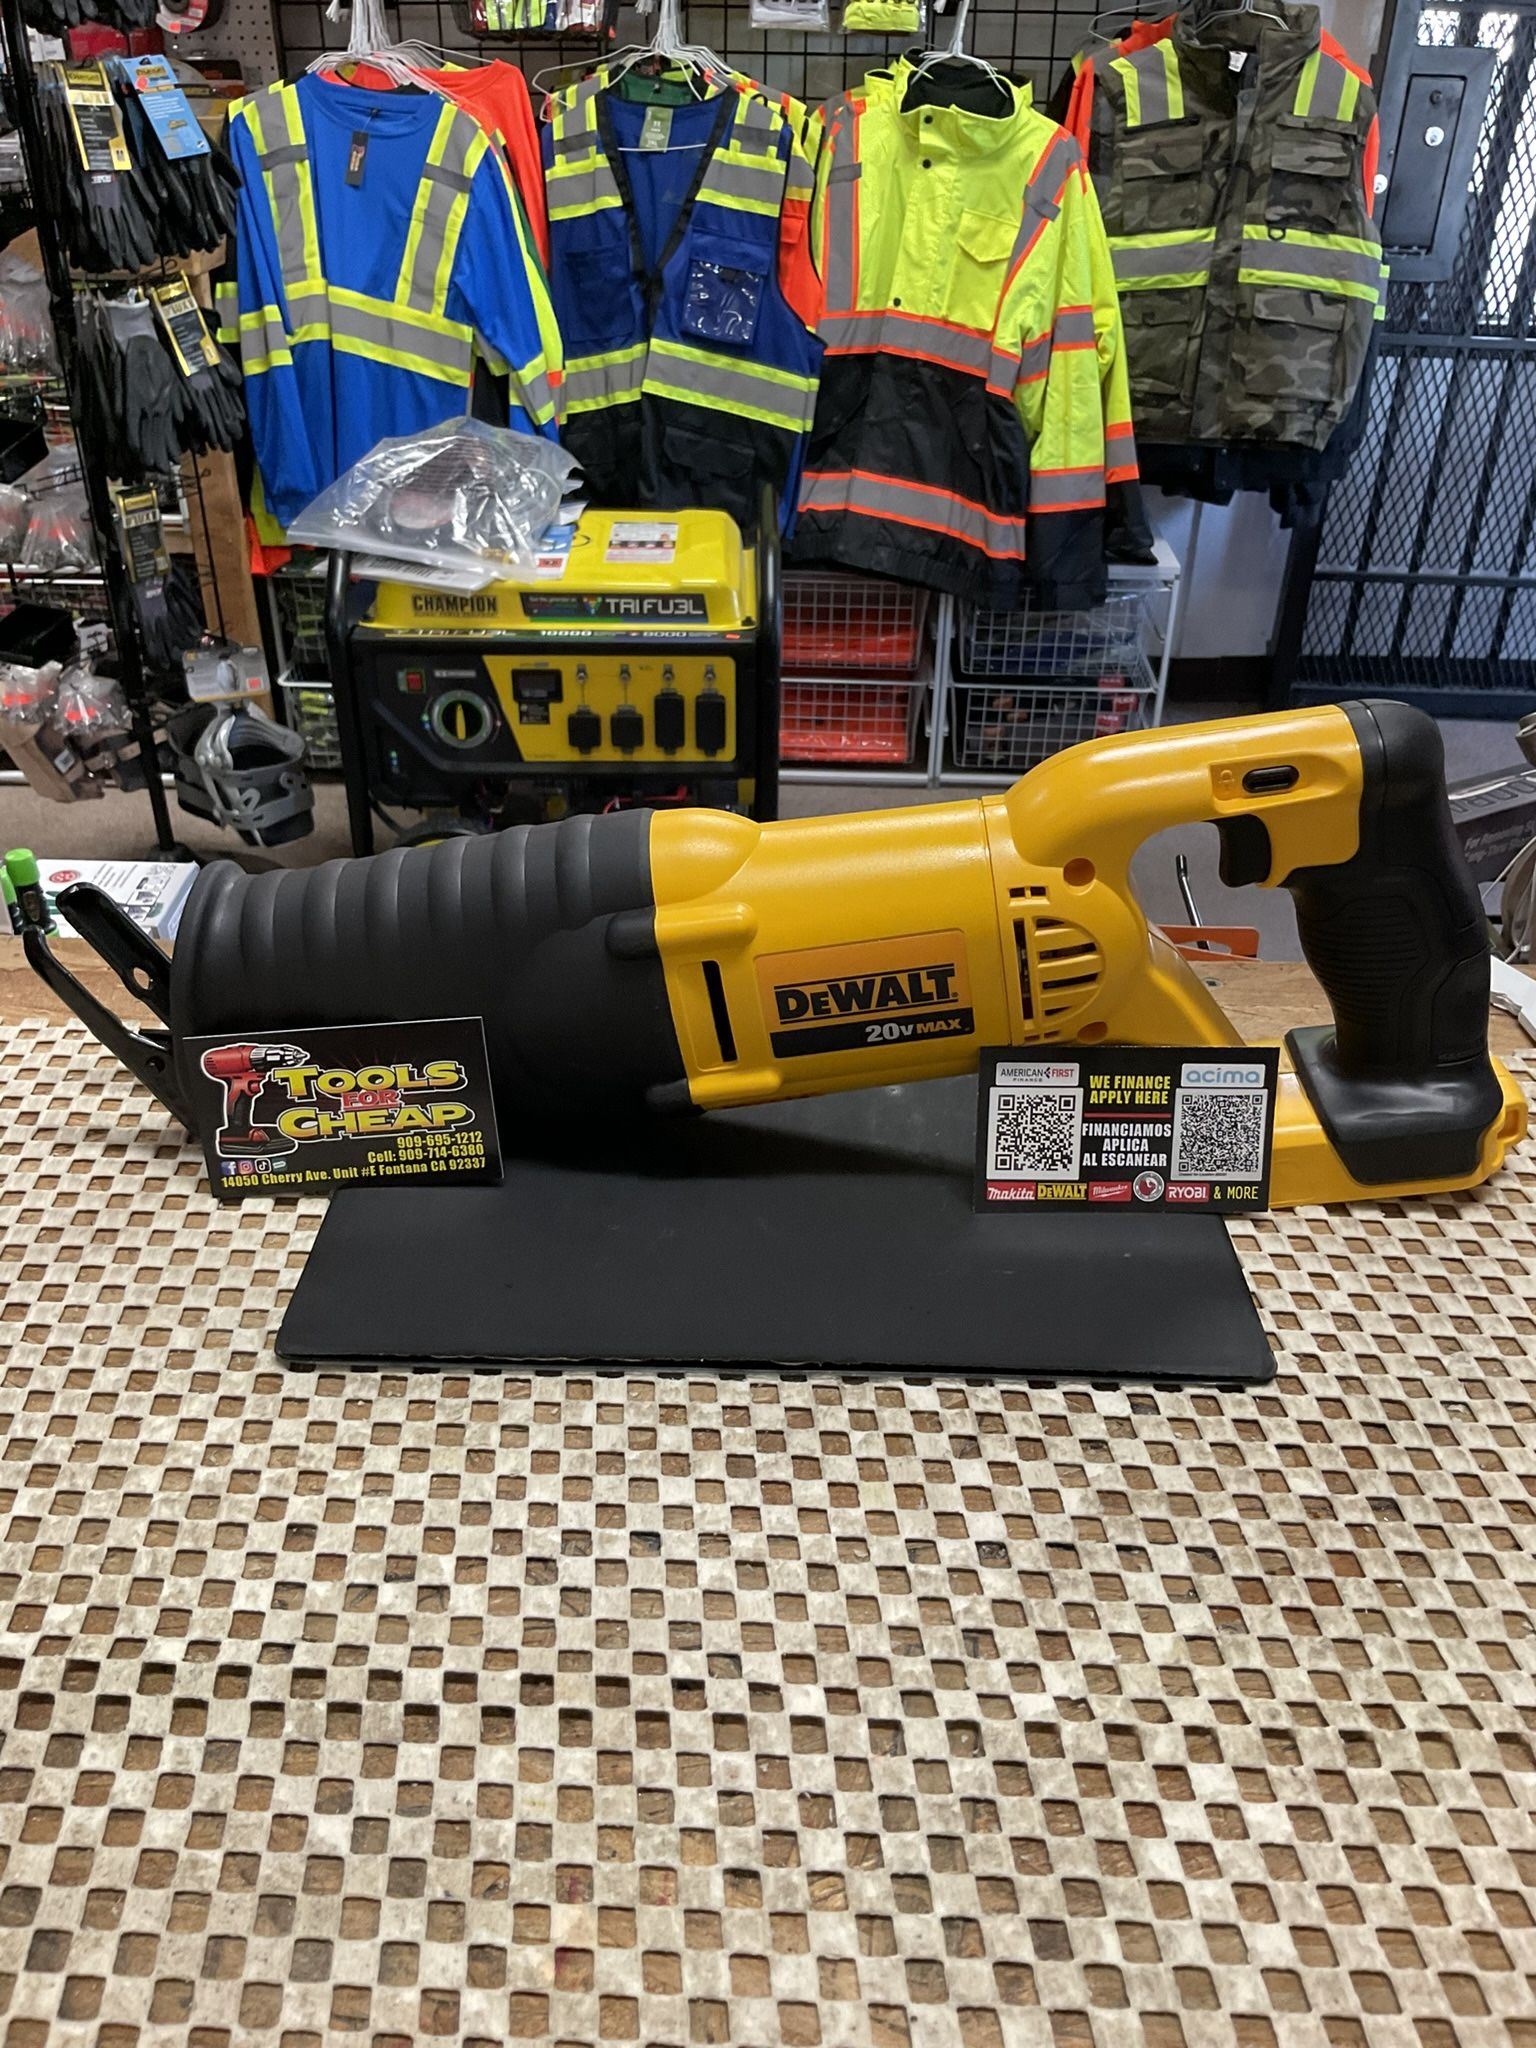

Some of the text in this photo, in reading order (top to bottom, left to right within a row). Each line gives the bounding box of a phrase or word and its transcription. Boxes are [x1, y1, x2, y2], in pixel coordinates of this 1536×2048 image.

[413, 594, 497, 612] CHAMPION
[916, 1018, 962, 1034] MAX
[273, 1062, 460, 1096] TOOLS
[1000, 1068, 1074, 1078] AMERICAN FIRST
[1090, 1075, 1171, 1089] WE FINANCE
[341, 1089, 400, 1108] FOR
[1090, 1090, 1168, 1104] APPLY HERE
[279, 1104, 467, 1138] CHEAP
[1082, 1123, 1172, 1137] FINANCIAMOS
[397, 1131, 483, 1148] 909-695-1212
[1102, 1138, 1149, 1151] APLICA
[367, 1143, 485, 1163] Cell: 909-714-6380
[1082, 1153, 1167, 1167] AL ESCANEAR
[221, 1157, 486, 1188] 14050 Cherry Ave. Unit #E Fontana CA 92337
[1168, 1186, 1207, 1200] RYOBI
[1213, 1186, 1259, 1200] & MORE
